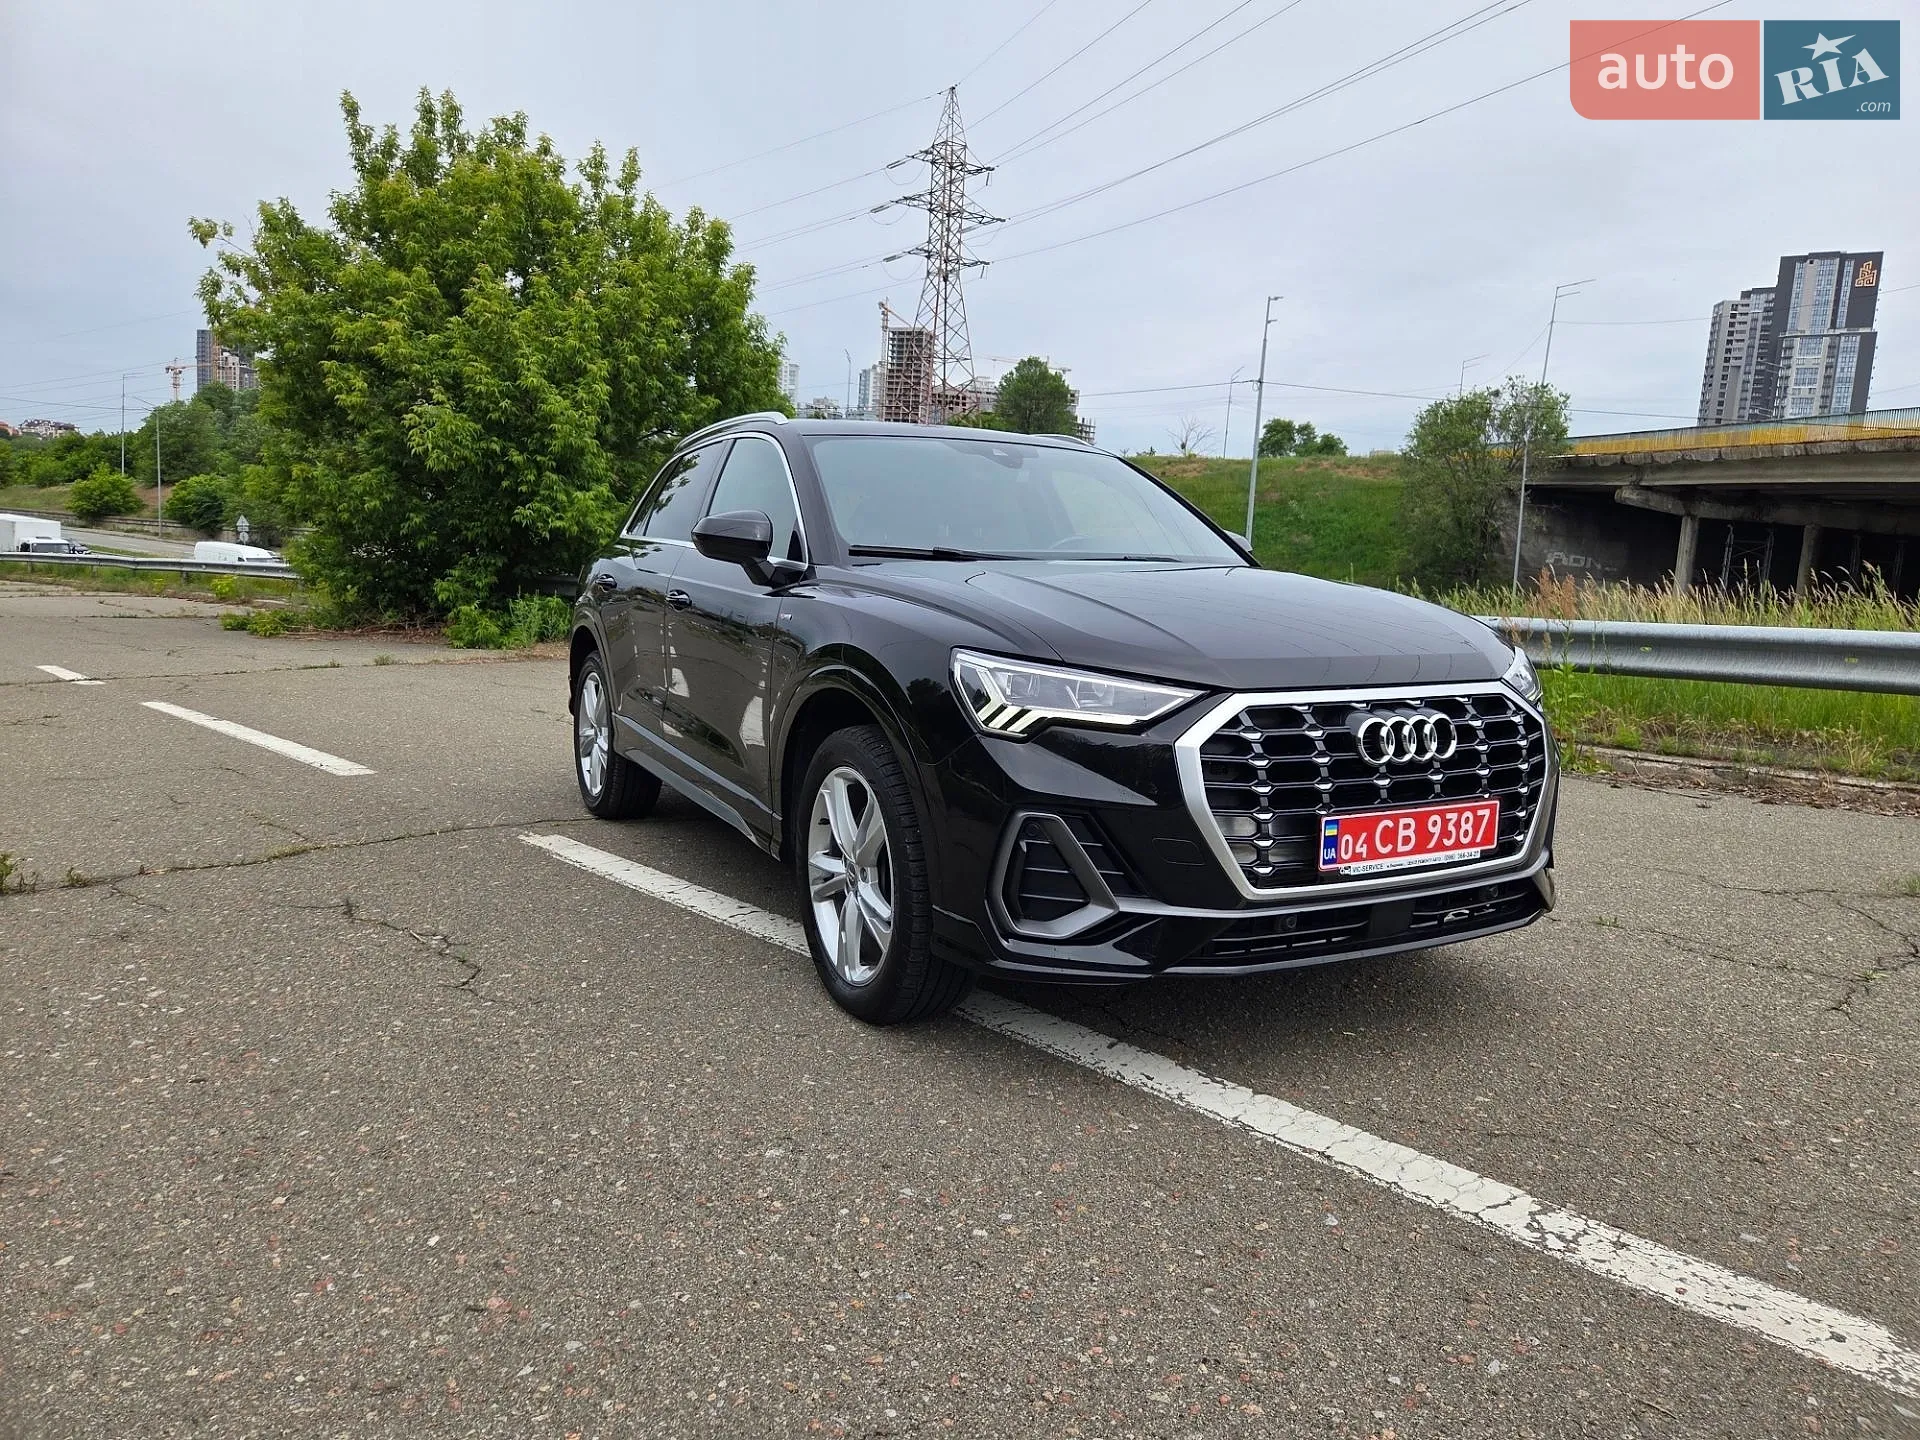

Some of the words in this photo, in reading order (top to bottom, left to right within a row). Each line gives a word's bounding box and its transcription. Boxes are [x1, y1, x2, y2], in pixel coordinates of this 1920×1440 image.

[1341, 833, 1368, 860] 04
[1375, 818, 1416, 854] CB
[1427, 809, 1491, 849] 9387
[1324, 848, 1336, 860] UA
